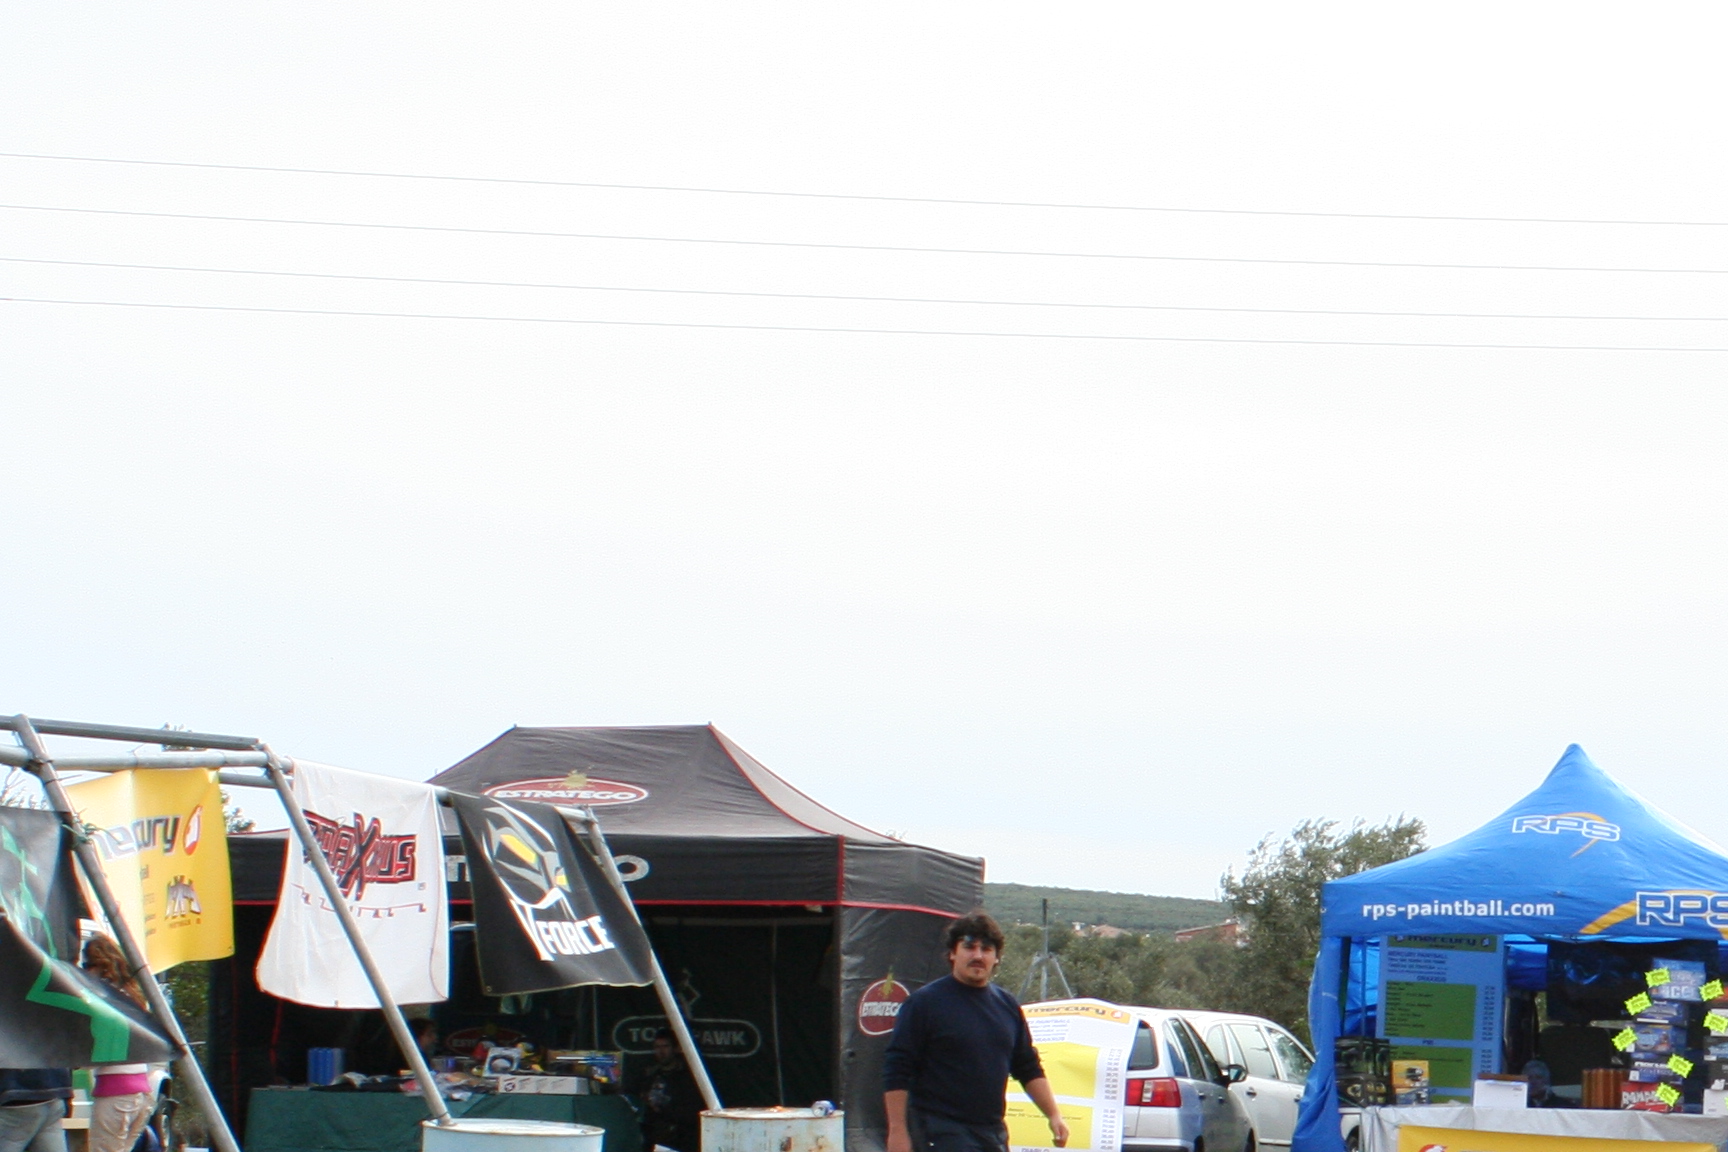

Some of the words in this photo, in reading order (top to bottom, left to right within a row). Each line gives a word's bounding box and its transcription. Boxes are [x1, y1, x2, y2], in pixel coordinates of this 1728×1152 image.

[494, 789, 637, 800] ESTRATEGO
[1512, 814, 1620, 841] RPS
[1362, 898, 1555, 920] rps-paintball.com
[628, 1027, 746, 1045] TOAWK
